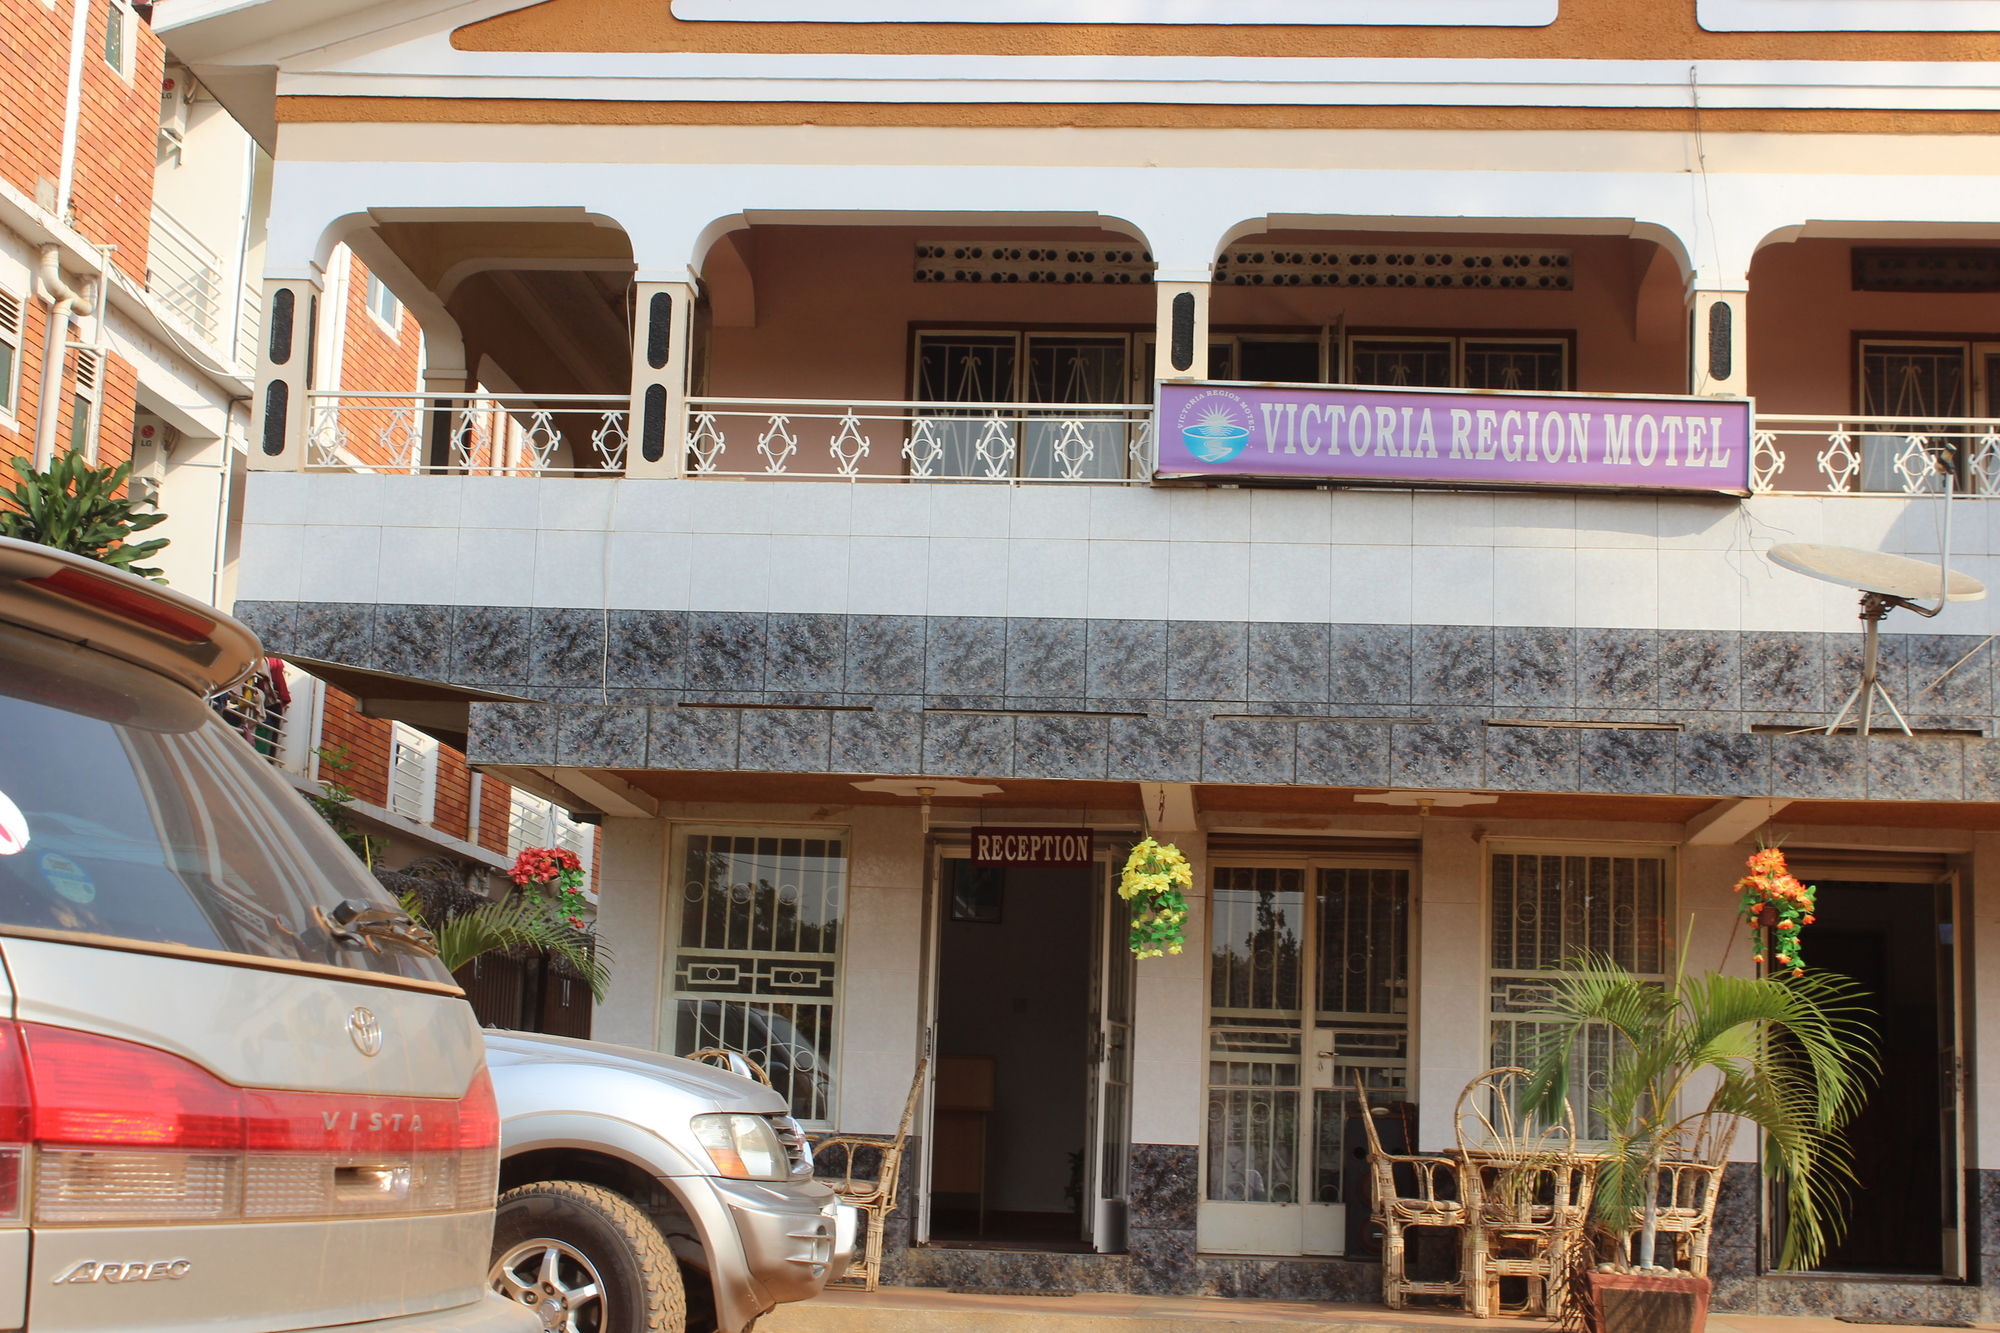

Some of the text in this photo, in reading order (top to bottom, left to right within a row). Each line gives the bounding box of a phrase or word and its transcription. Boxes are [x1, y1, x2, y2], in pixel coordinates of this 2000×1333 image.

[1177, 389, 1255, 431] VICTORIA REGION MOTEL
[1260, 402, 1731, 468] VICTORIA REGION MOTEL
[977, 835, 1089, 861] RECEPTION
[321, 1111, 423, 1132] VISTA
[52, 1258, 191, 1285] ARDEO
